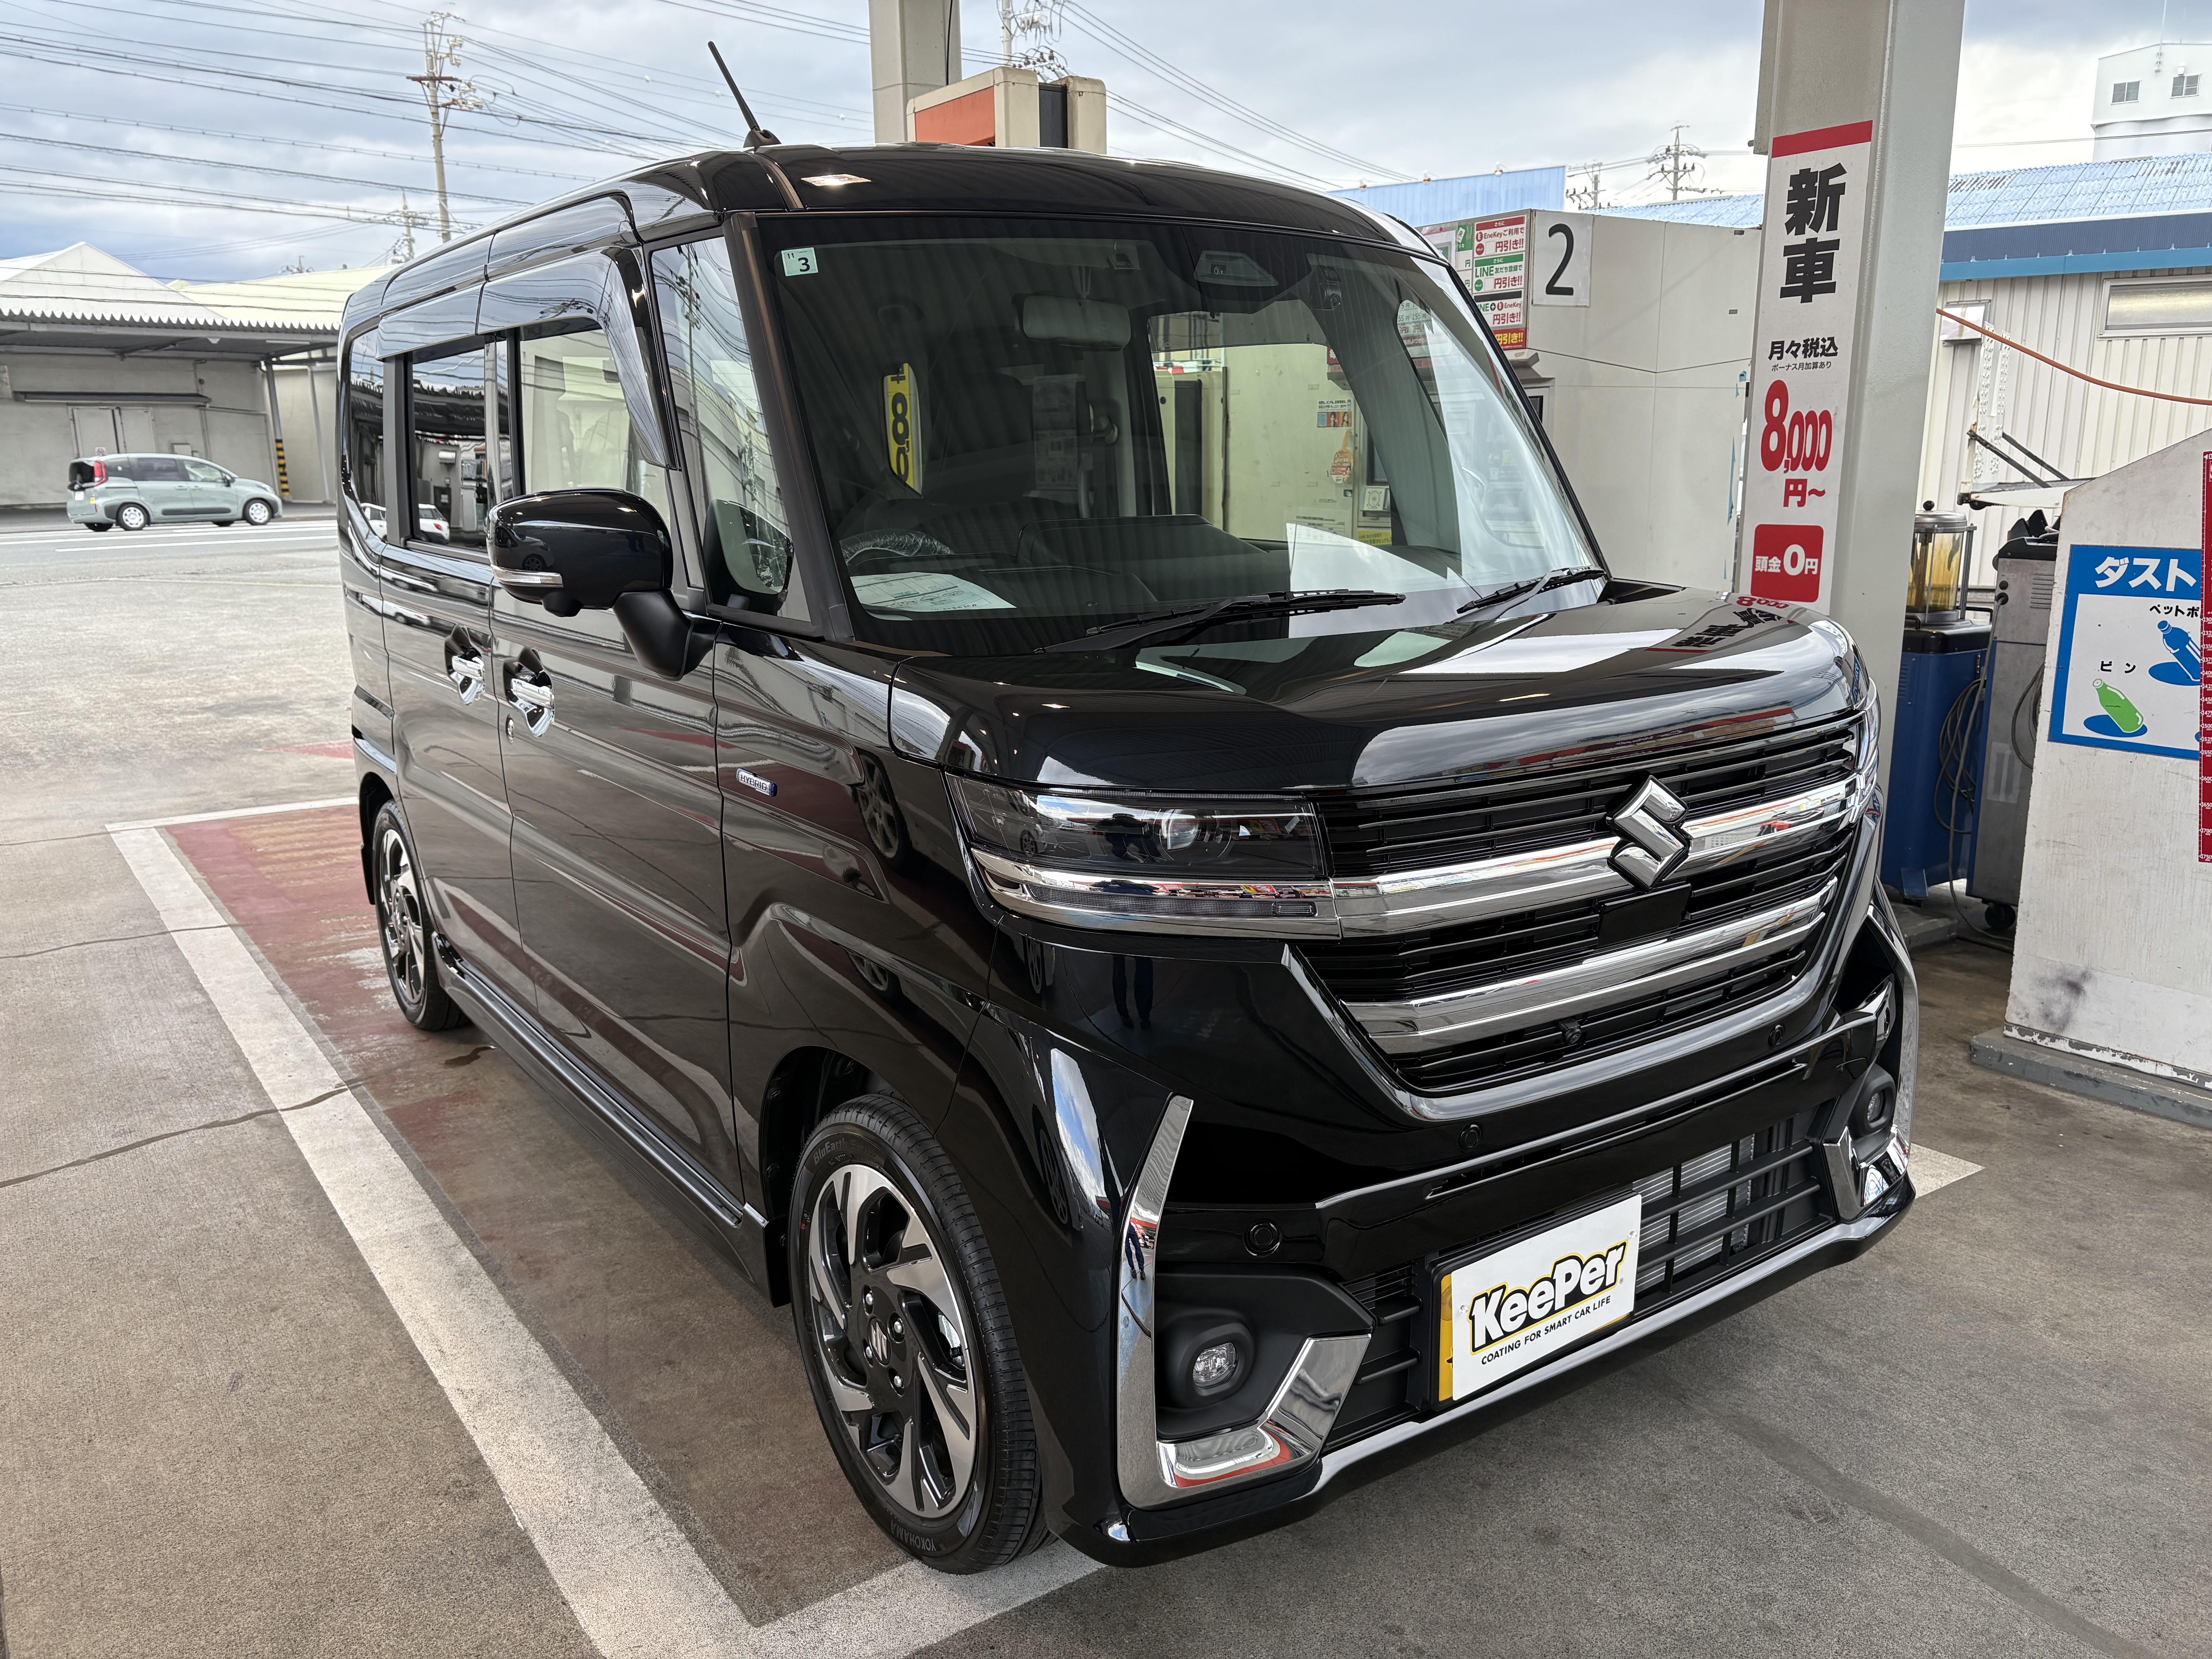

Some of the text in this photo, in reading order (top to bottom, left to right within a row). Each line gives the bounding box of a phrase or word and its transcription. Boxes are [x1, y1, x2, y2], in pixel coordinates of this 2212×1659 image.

[1780, 163, 1847, 304] 新車
[798, 257, 810, 272] 3
[1475, 266, 1494, 278] LINE
[1546, 223, 1574, 295] 2
[1768, 337, 1838, 361] 月々税込
[1761, 380, 1832, 473] 8,000
[1755, 544, 1819, 576] 頭金0円
[2095, 556, 2197, 592] ダスト
[740, 773, 767, 791] HYBRID
[813, 1138, 847, 1165] BluEarth
[1469, 1241, 1626, 1353] KeePer
[1481, 1295, 1611, 1365] COATING FOR SMART CAR LIFE
[891, 1520, 936, 1551] YOKOHAMA
